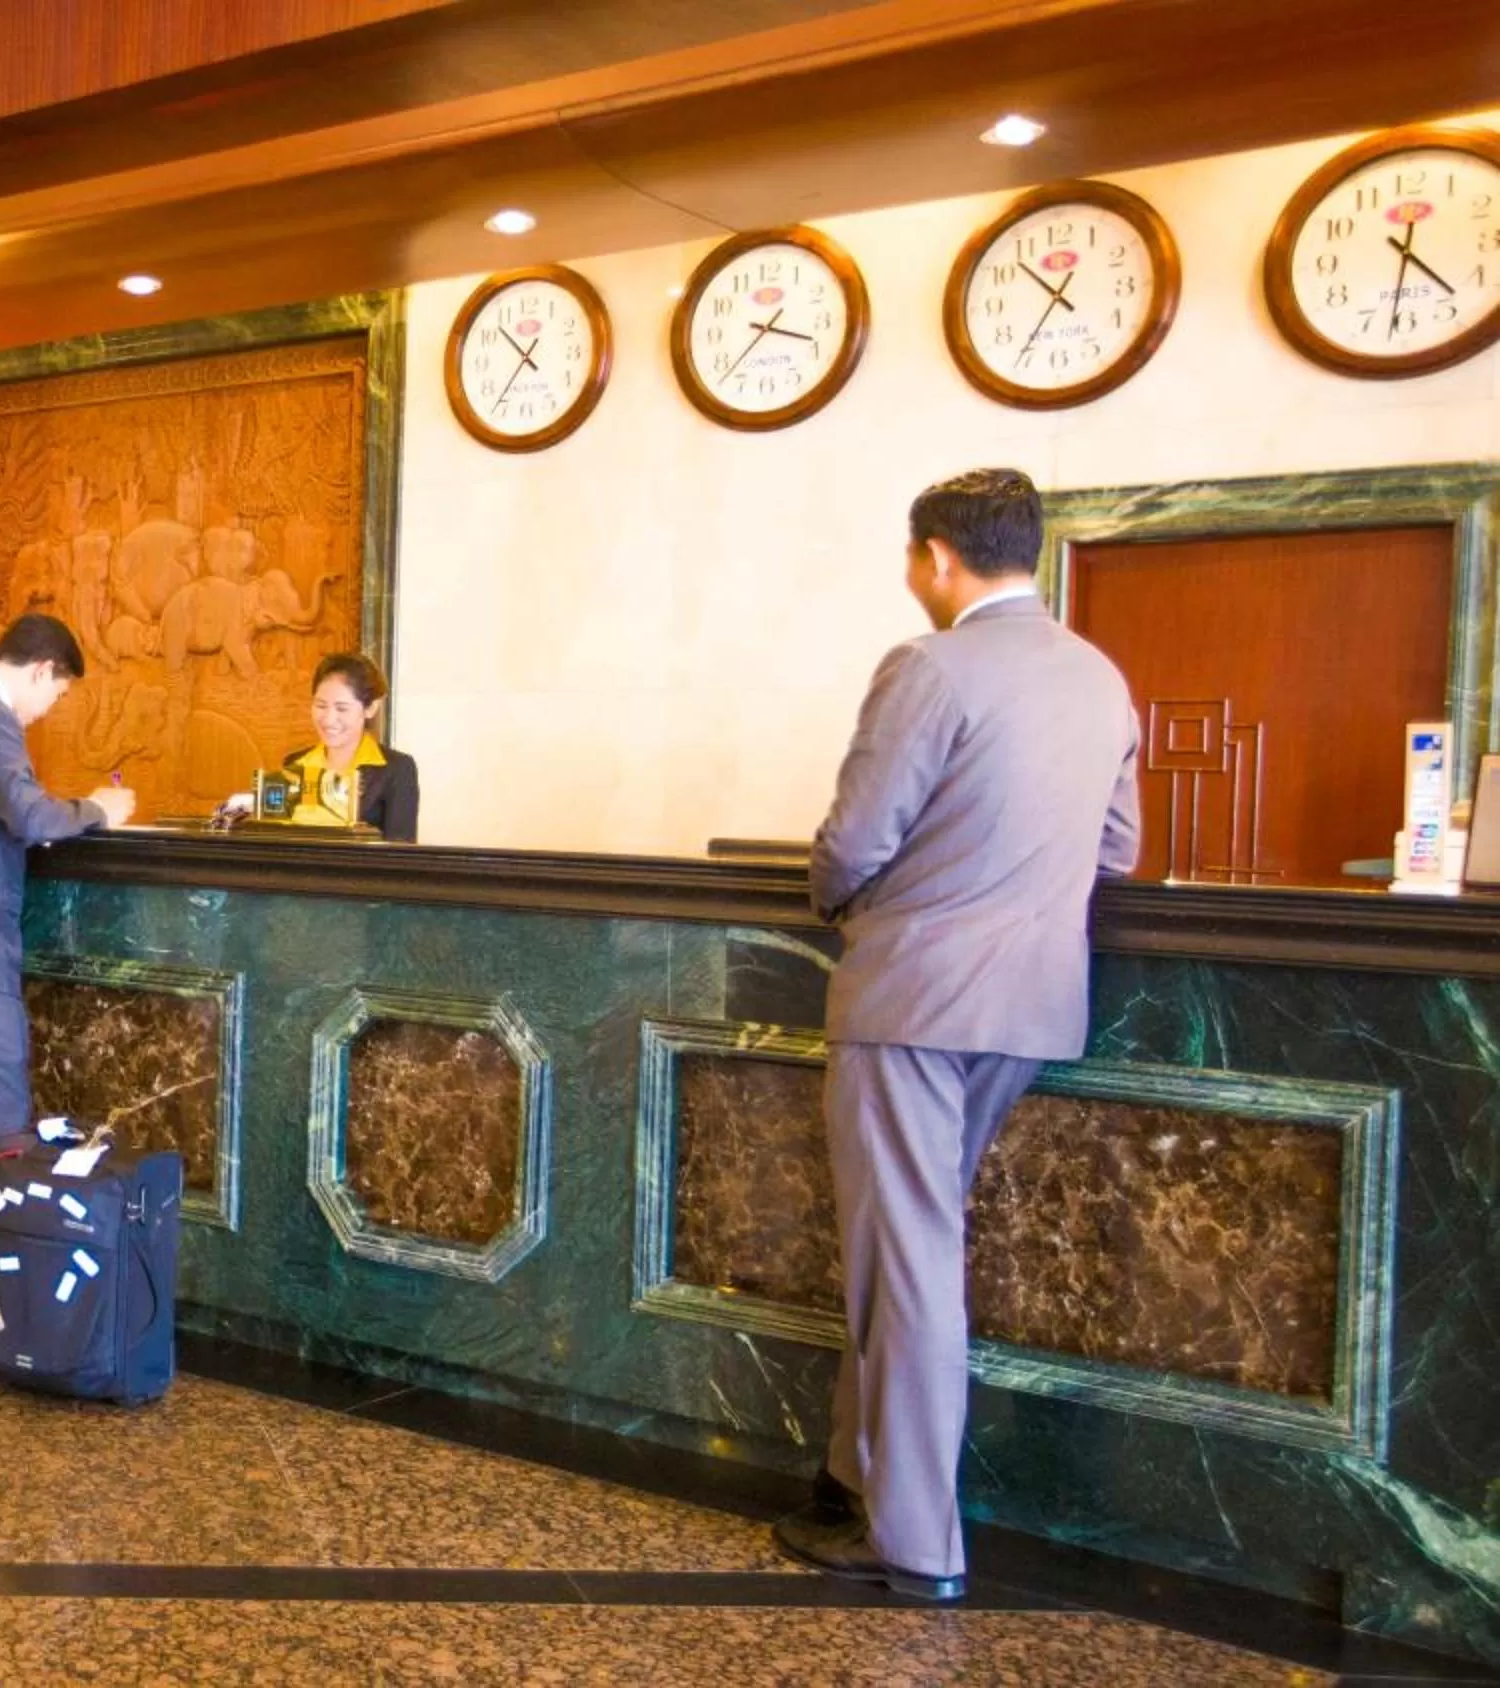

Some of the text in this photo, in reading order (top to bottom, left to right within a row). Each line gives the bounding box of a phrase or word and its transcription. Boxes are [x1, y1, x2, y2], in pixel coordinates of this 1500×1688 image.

[1395, 171, 1427, 195] 12
[1447, 172, 1454, 197] 1
[1355, 186, 1378, 212] 11
[1471, 195, 1493, 220] 2
[1047, 224, 1073, 247] 12
[1089, 224, 1095, 250] 1
[1327, 217, 1354, 241] 10
[1016, 237, 1035, 262] 11
[1107, 245, 1125, 268] 2
[759, 263, 781, 283] 12
[794, 264, 800, 286] 1
[993, 265, 1015, 286] 10
[1316, 254, 1338, 277] 9
[1466, 264, 1485, 288] 4
[733, 272, 749, 293] 11
[1115, 275, 1135, 296] 3
[808, 284, 825, 305] 2
[1326, 284, 1348, 308] 8
[1379, 285, 1432, 303] PARIS
[497, 305, 512, 326] 11
[520, 296, 539, 315] 12
[549, 300, 555, 320] 1
[713, 296, 733, 318] 10
[985, 298, 1003, 317] 9
[1433, 296, 1457, 322] 5
[563, 318, 575, 337] 2
[814, 312, 831, 330] 3
[1108, 307, 1121, 329] 4
[1357, 308, 1377, 333] 7
[1393, 310, 1417, 334] 6
[481, 328, 497, 348] 10
[707, 326, 723, 344] 9
[994, 324, 1013, 345] 8
[1021, 346, 1034, 369] 7
[1080, 336, 1101, 360] 5
[713, 352, 729, 372] 8
[1049, 351, 1069, 369] 6
[480, 379, 495, 396] 8
[734, 372, 746, 394] 7
[759, 375, 775, 394] 6
[785, 367, 802, 386] 5
